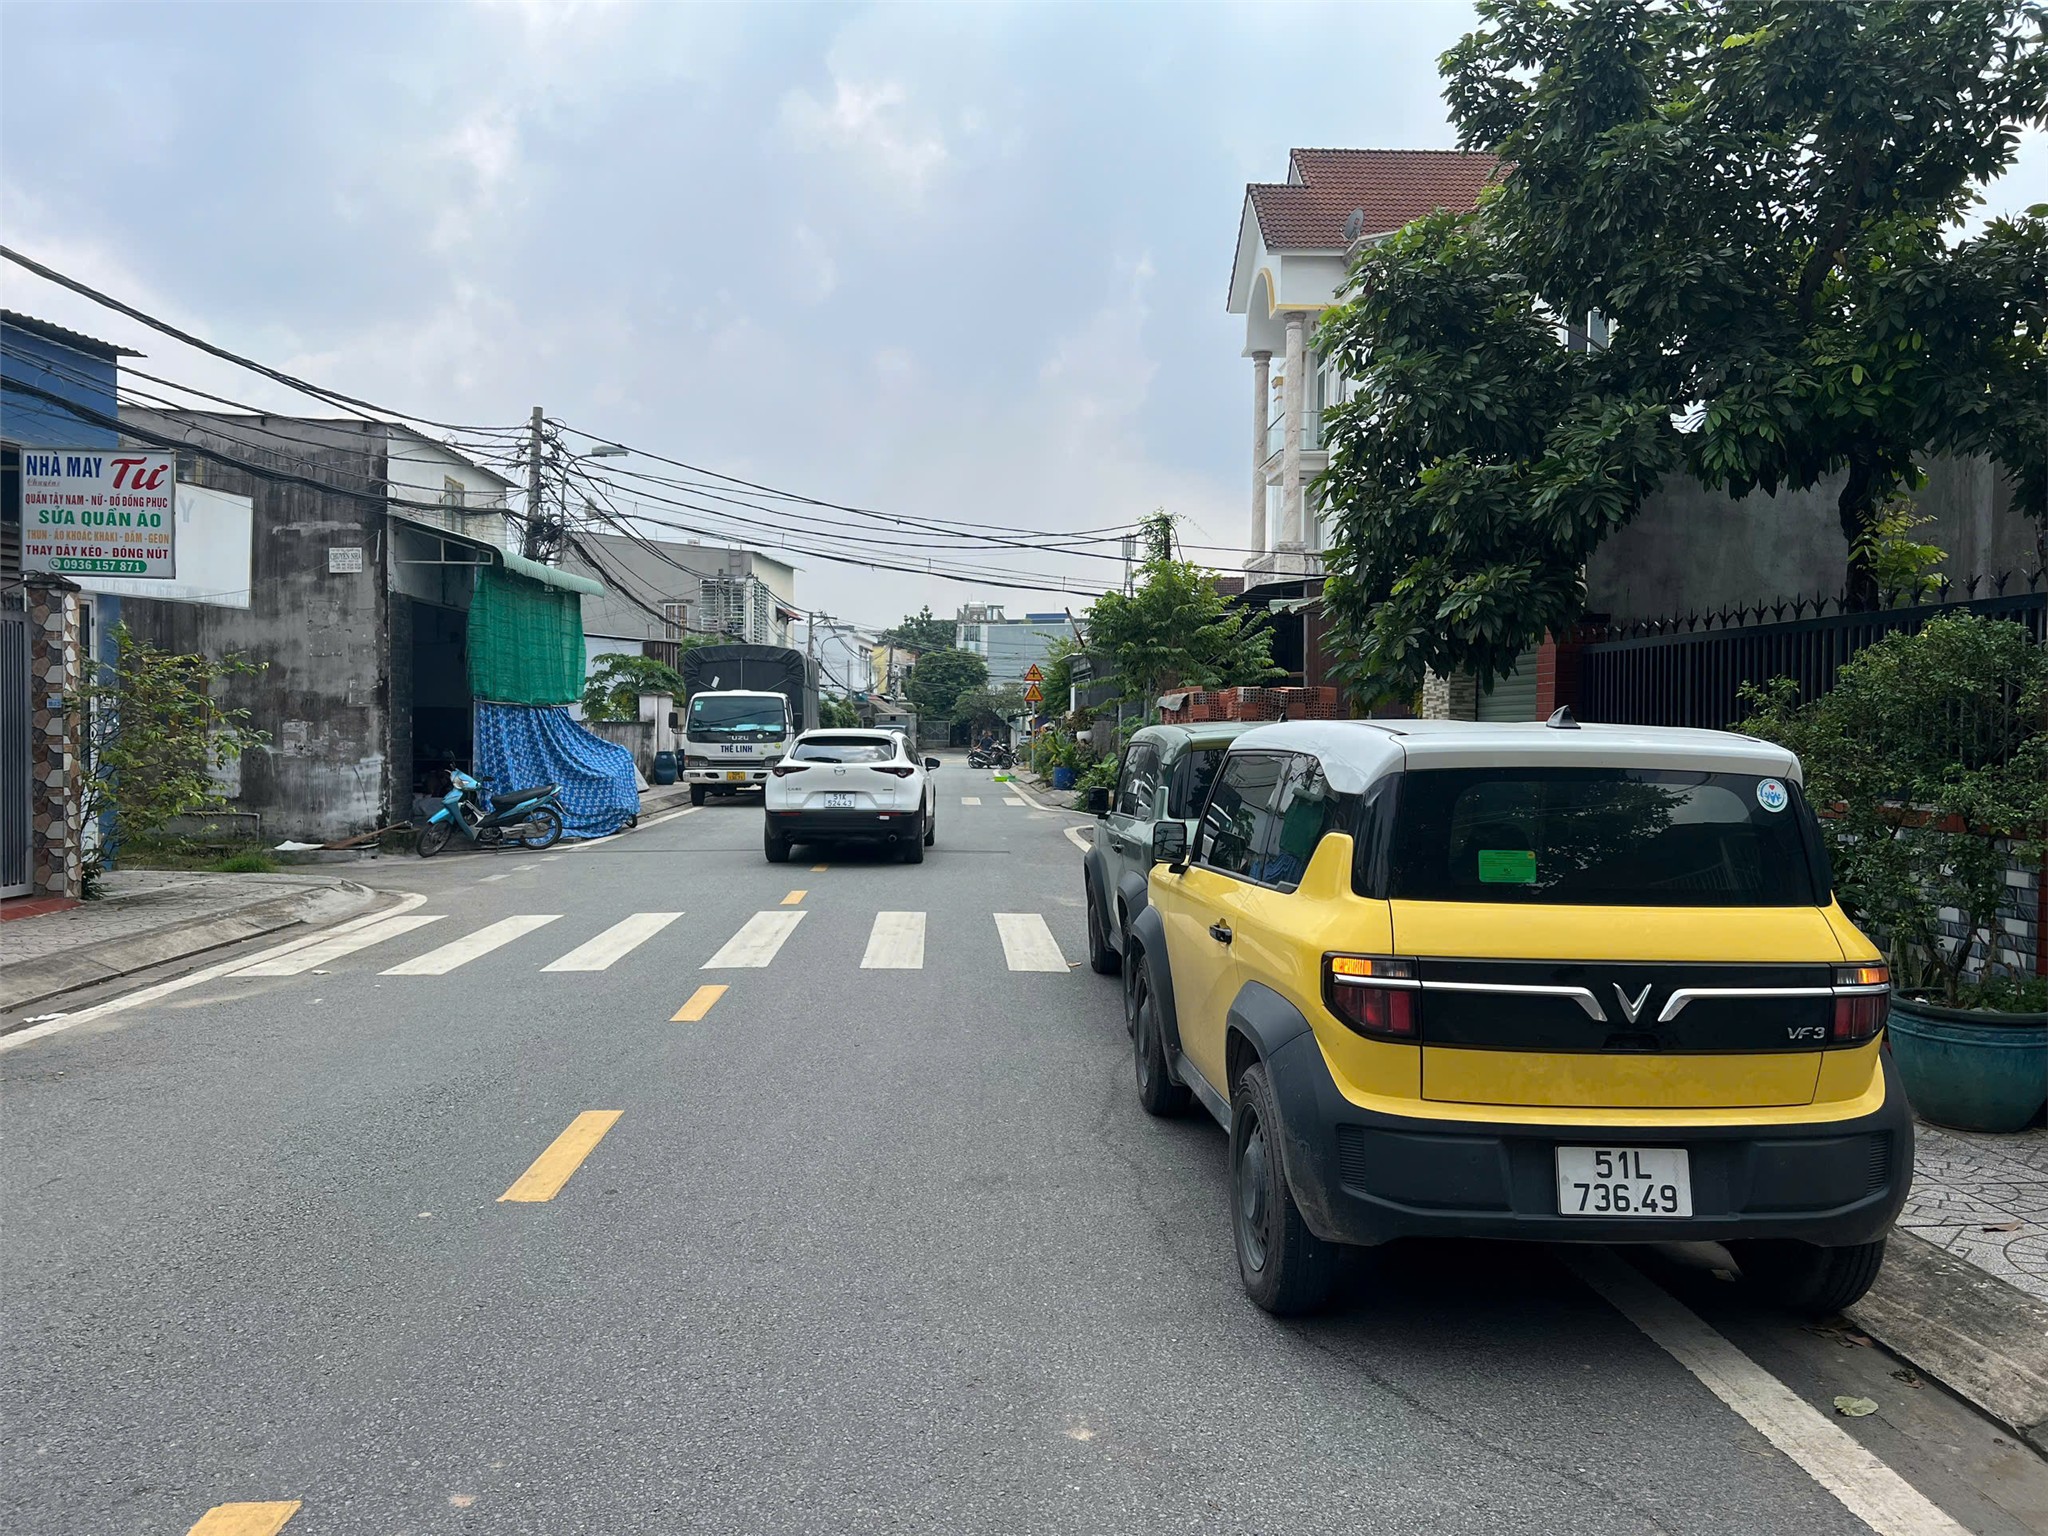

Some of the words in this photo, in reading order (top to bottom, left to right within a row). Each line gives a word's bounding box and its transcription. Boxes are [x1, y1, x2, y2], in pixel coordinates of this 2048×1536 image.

[26, 451, 61, 477] NHÀ
[66, 456, 103, 478] MAY
[110, 456, 169, 491] Tư
[65, 494, 84, 506] NAM
[146, 497, 168, 511] PHỤC
[38, 505, 76, 525] SỬA
[81, 507, 132, 528] QUẦN
[136, 509, 162, 528] ÁO
[27, 529, 48, 541] THUN
[93, 530, 118, 543] KHAKI
[25, 544, 53, 556] THAY
[56, 543, 78, 557] DÂY
[80, 544, 102, 558] KÉO
[112, 545, 144, 559] ĐÓNG
[146, 546, 169, 559] NÚT
[63, 559, 92, 570] 0936
[95, 560, 116, 571] 157
[119, 561, 141, 572] 871
[735, 745, 753, 753] LINH
[1595, 1150, 1653, 1180] 51L
[1573, 1183, 1678, 1213] 736.49
